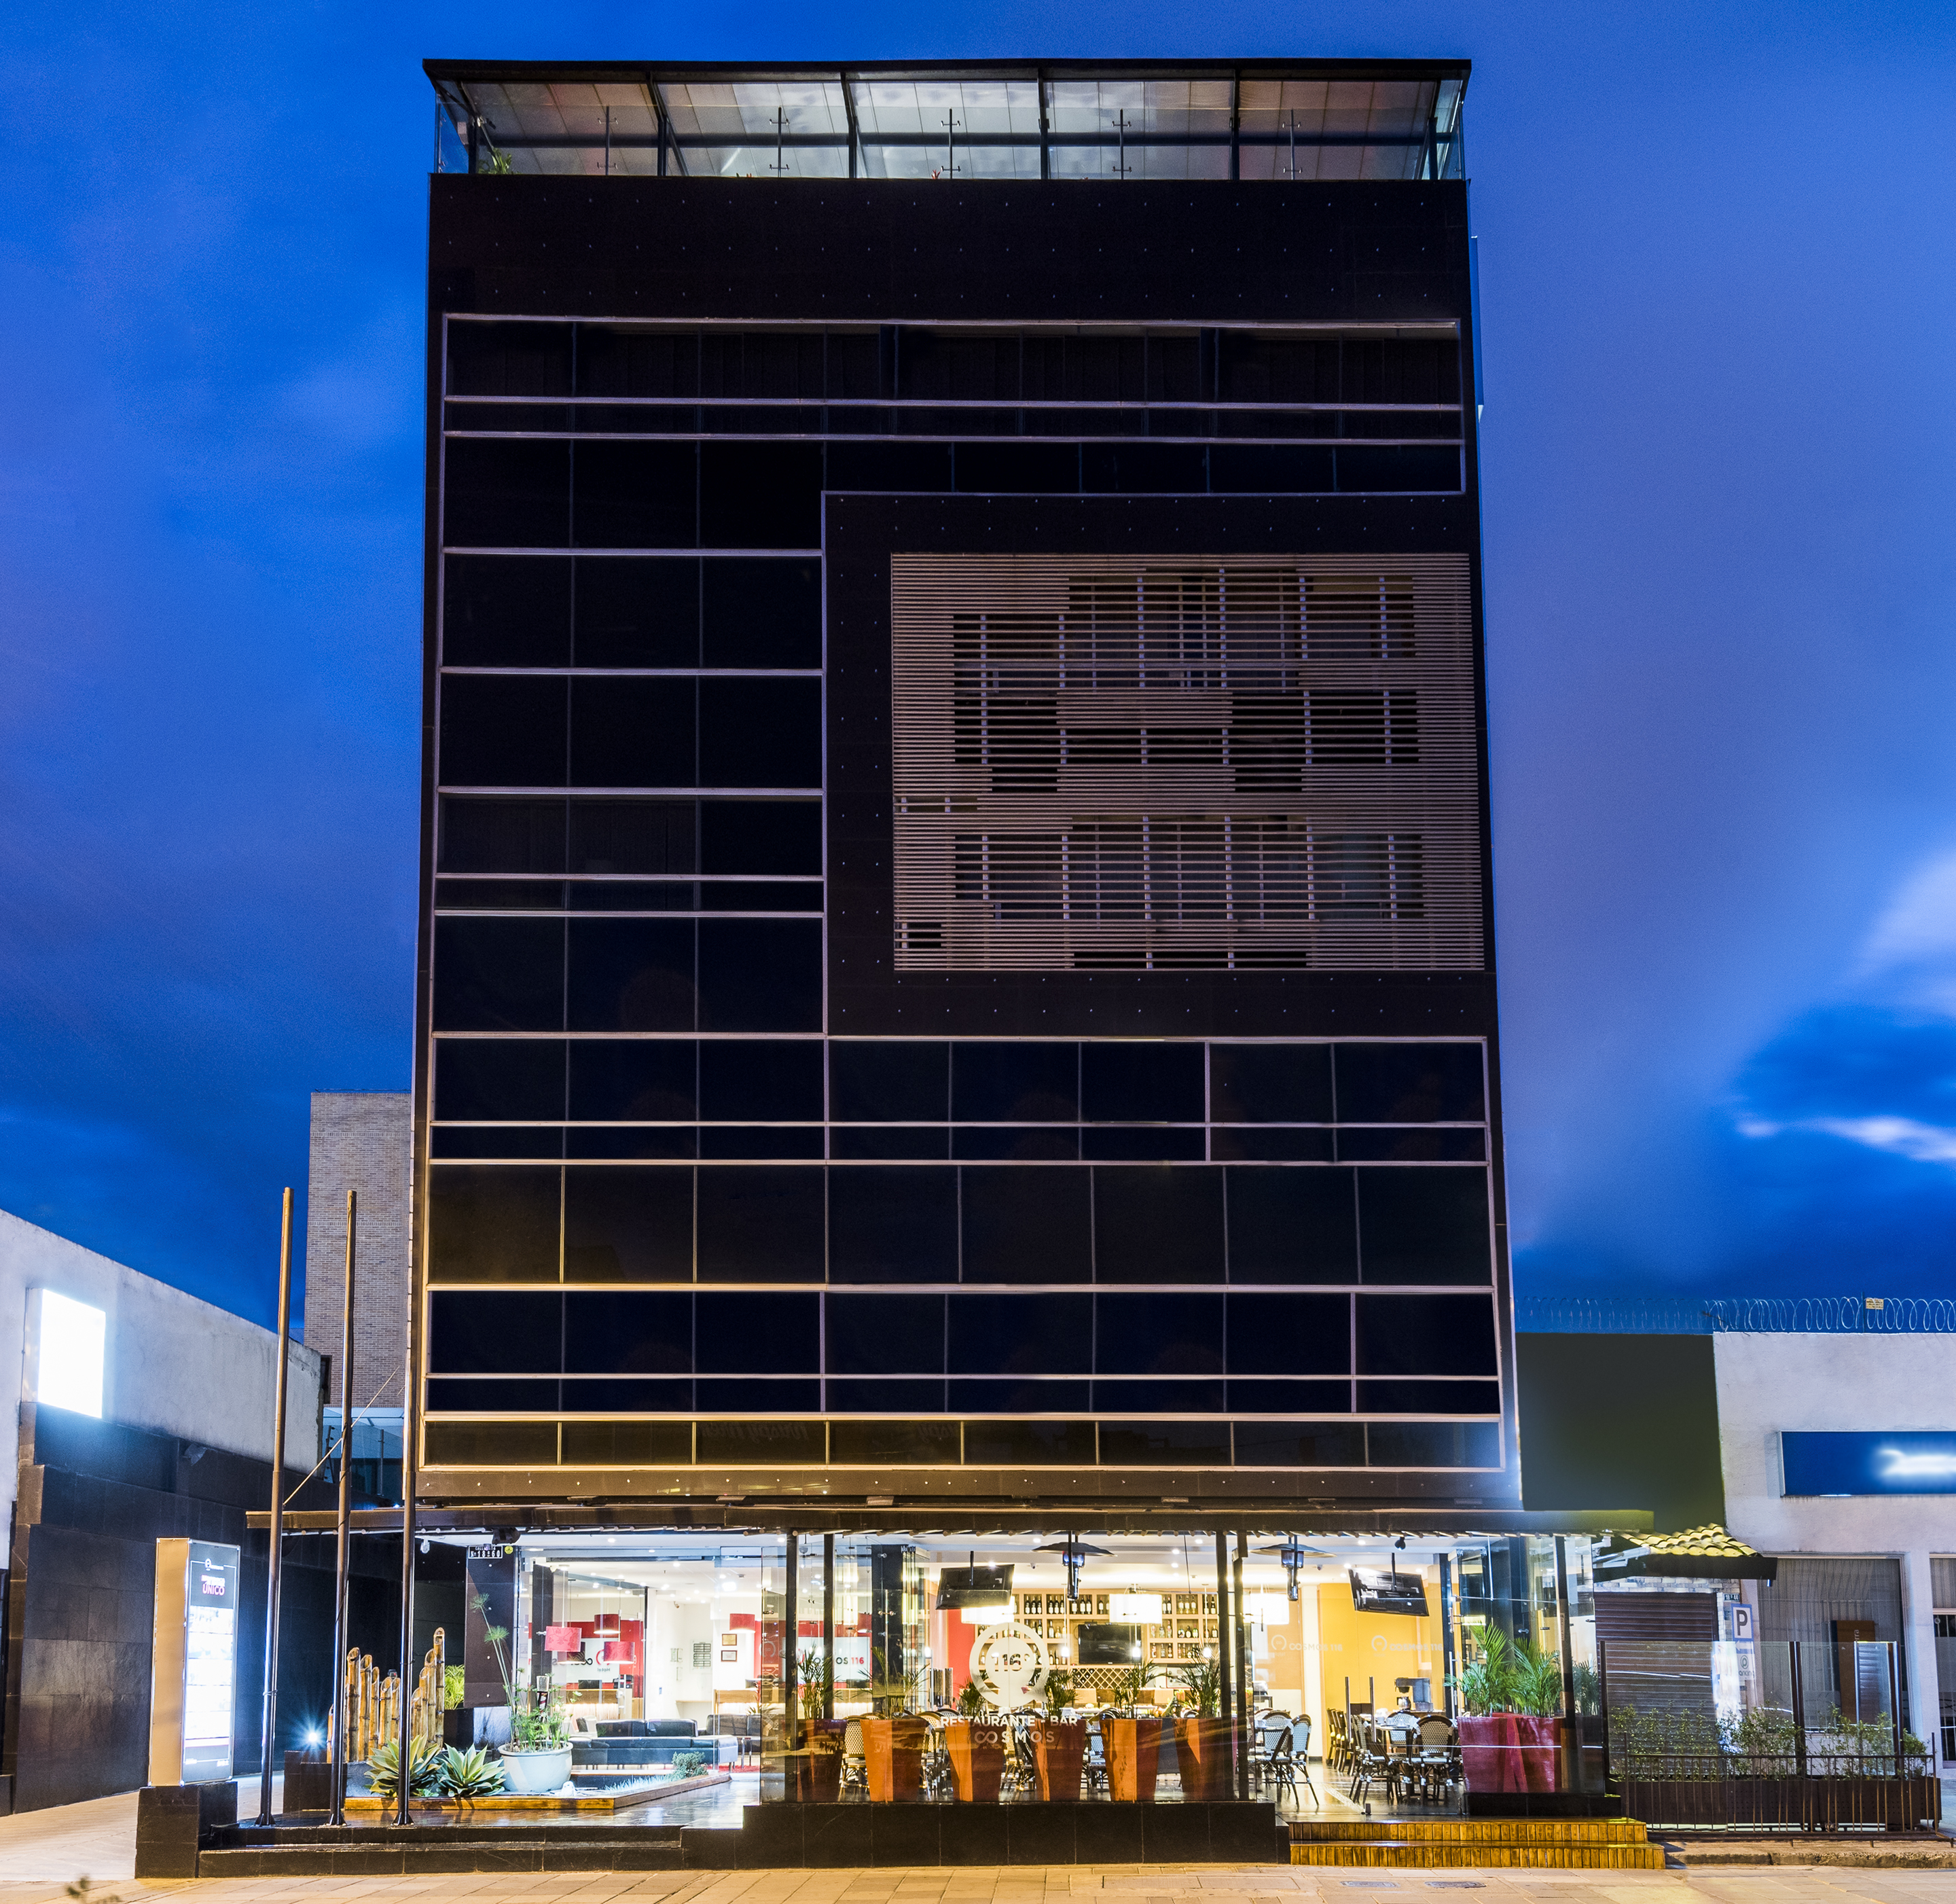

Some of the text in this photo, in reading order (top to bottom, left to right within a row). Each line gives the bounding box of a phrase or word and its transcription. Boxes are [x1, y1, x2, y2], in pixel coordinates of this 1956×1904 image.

[1736, 1610, 1748, 1636] P
[940, 1715, 1036, 1727] RESTAURANTE
[1050, 1715, 1079, 1727] BAR
[974, 1730, 1055, 1744] COSMOS
